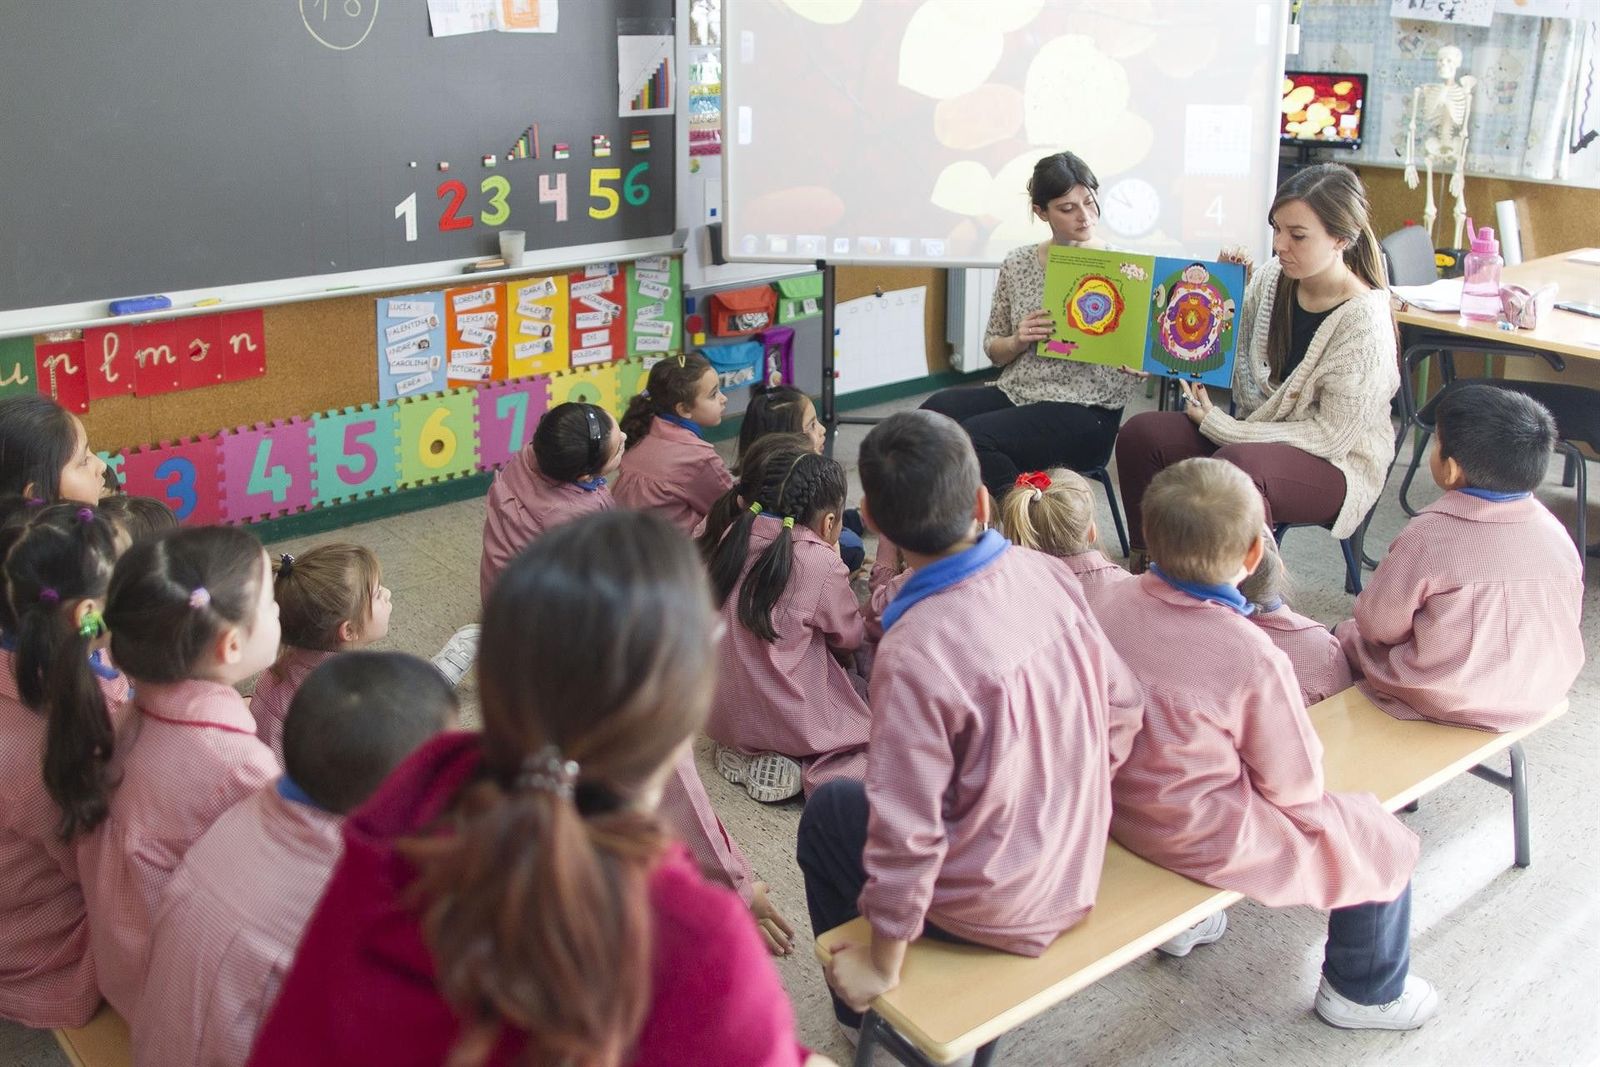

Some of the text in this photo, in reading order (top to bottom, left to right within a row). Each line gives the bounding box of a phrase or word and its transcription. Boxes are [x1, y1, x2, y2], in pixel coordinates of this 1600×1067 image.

[395, 162, 650, 242] 1 2 3 4 5 6
[100, 332, 120, 382] l
[134, 345, 177, 368] m
[154, 392, 529, 520] 3 4 5 6 7
